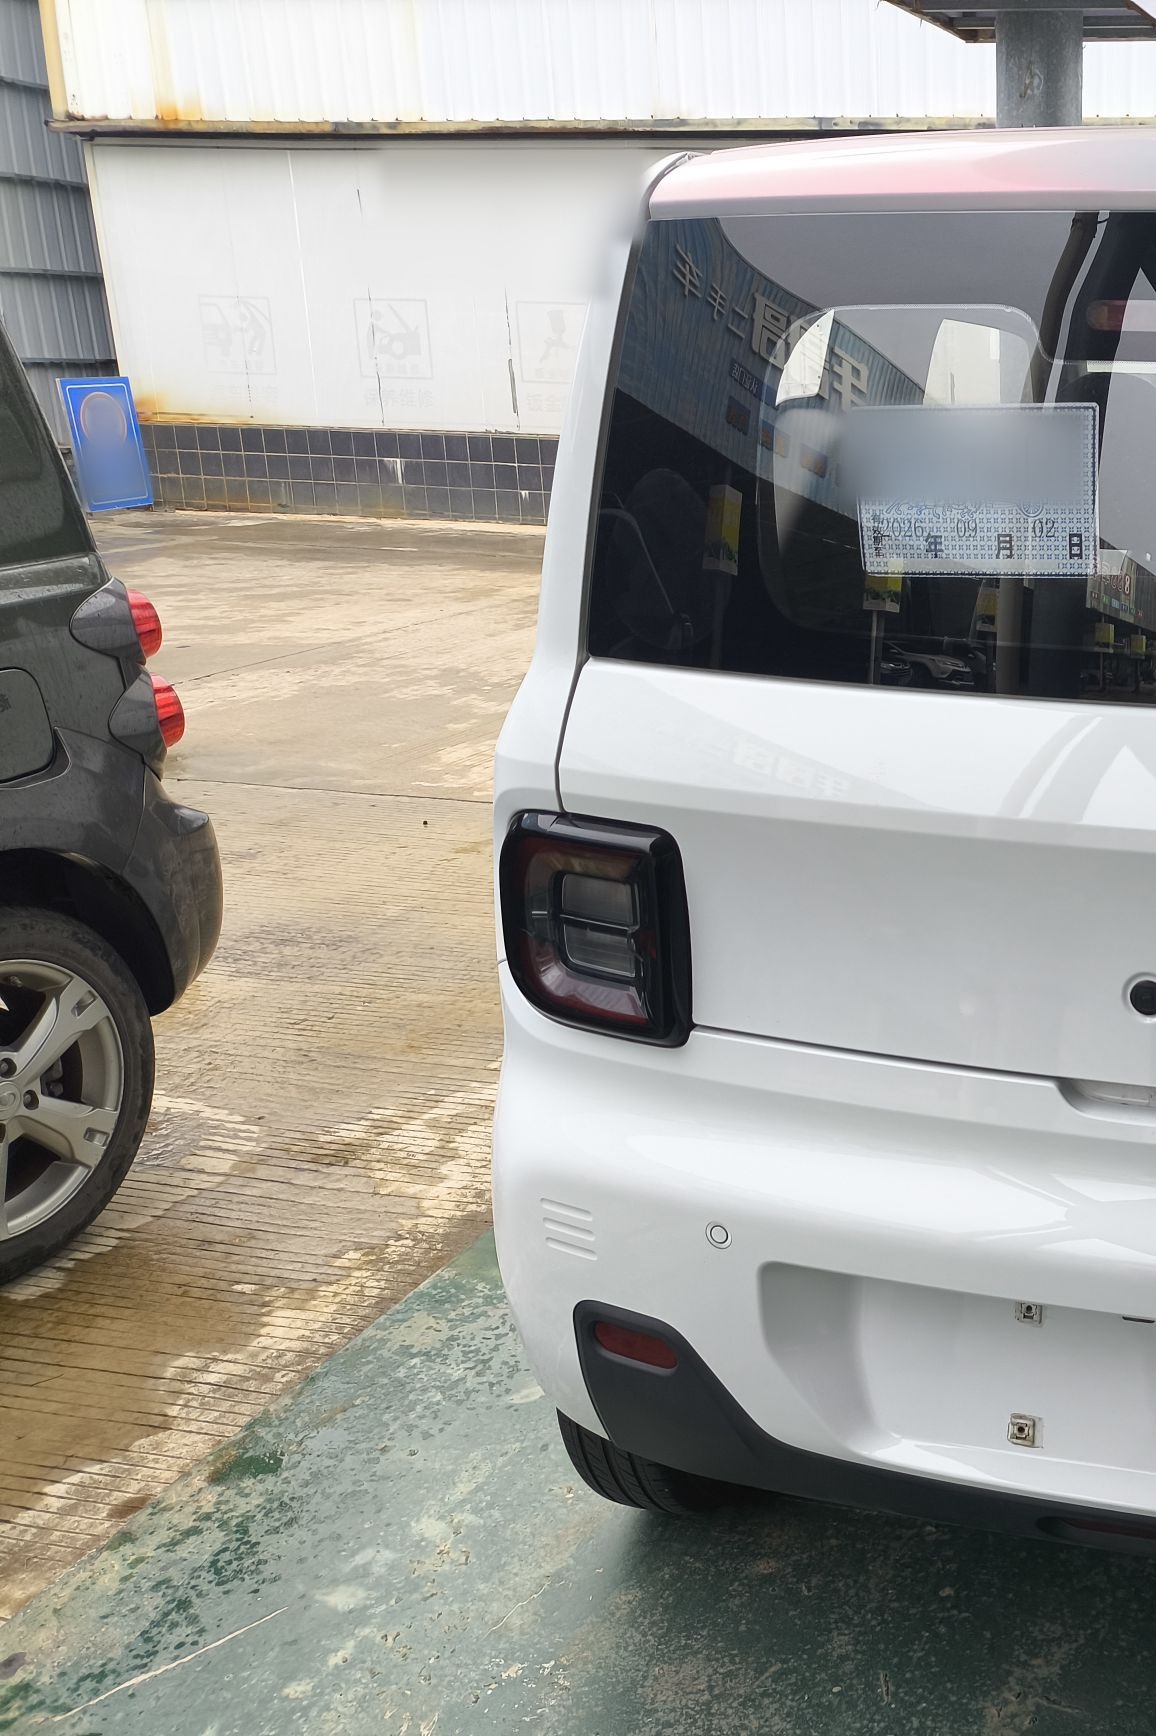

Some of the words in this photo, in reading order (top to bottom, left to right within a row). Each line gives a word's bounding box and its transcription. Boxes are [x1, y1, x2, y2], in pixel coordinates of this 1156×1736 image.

[881, 519, 924, 538] 2026
[925, 532, 945, 559] 年
[956, 519, 978, 538] 09
[996, 533, 1013, 559] 月
[1033, 519, 1056, 538] 02
[1068, 533, 1083, 559] 日
